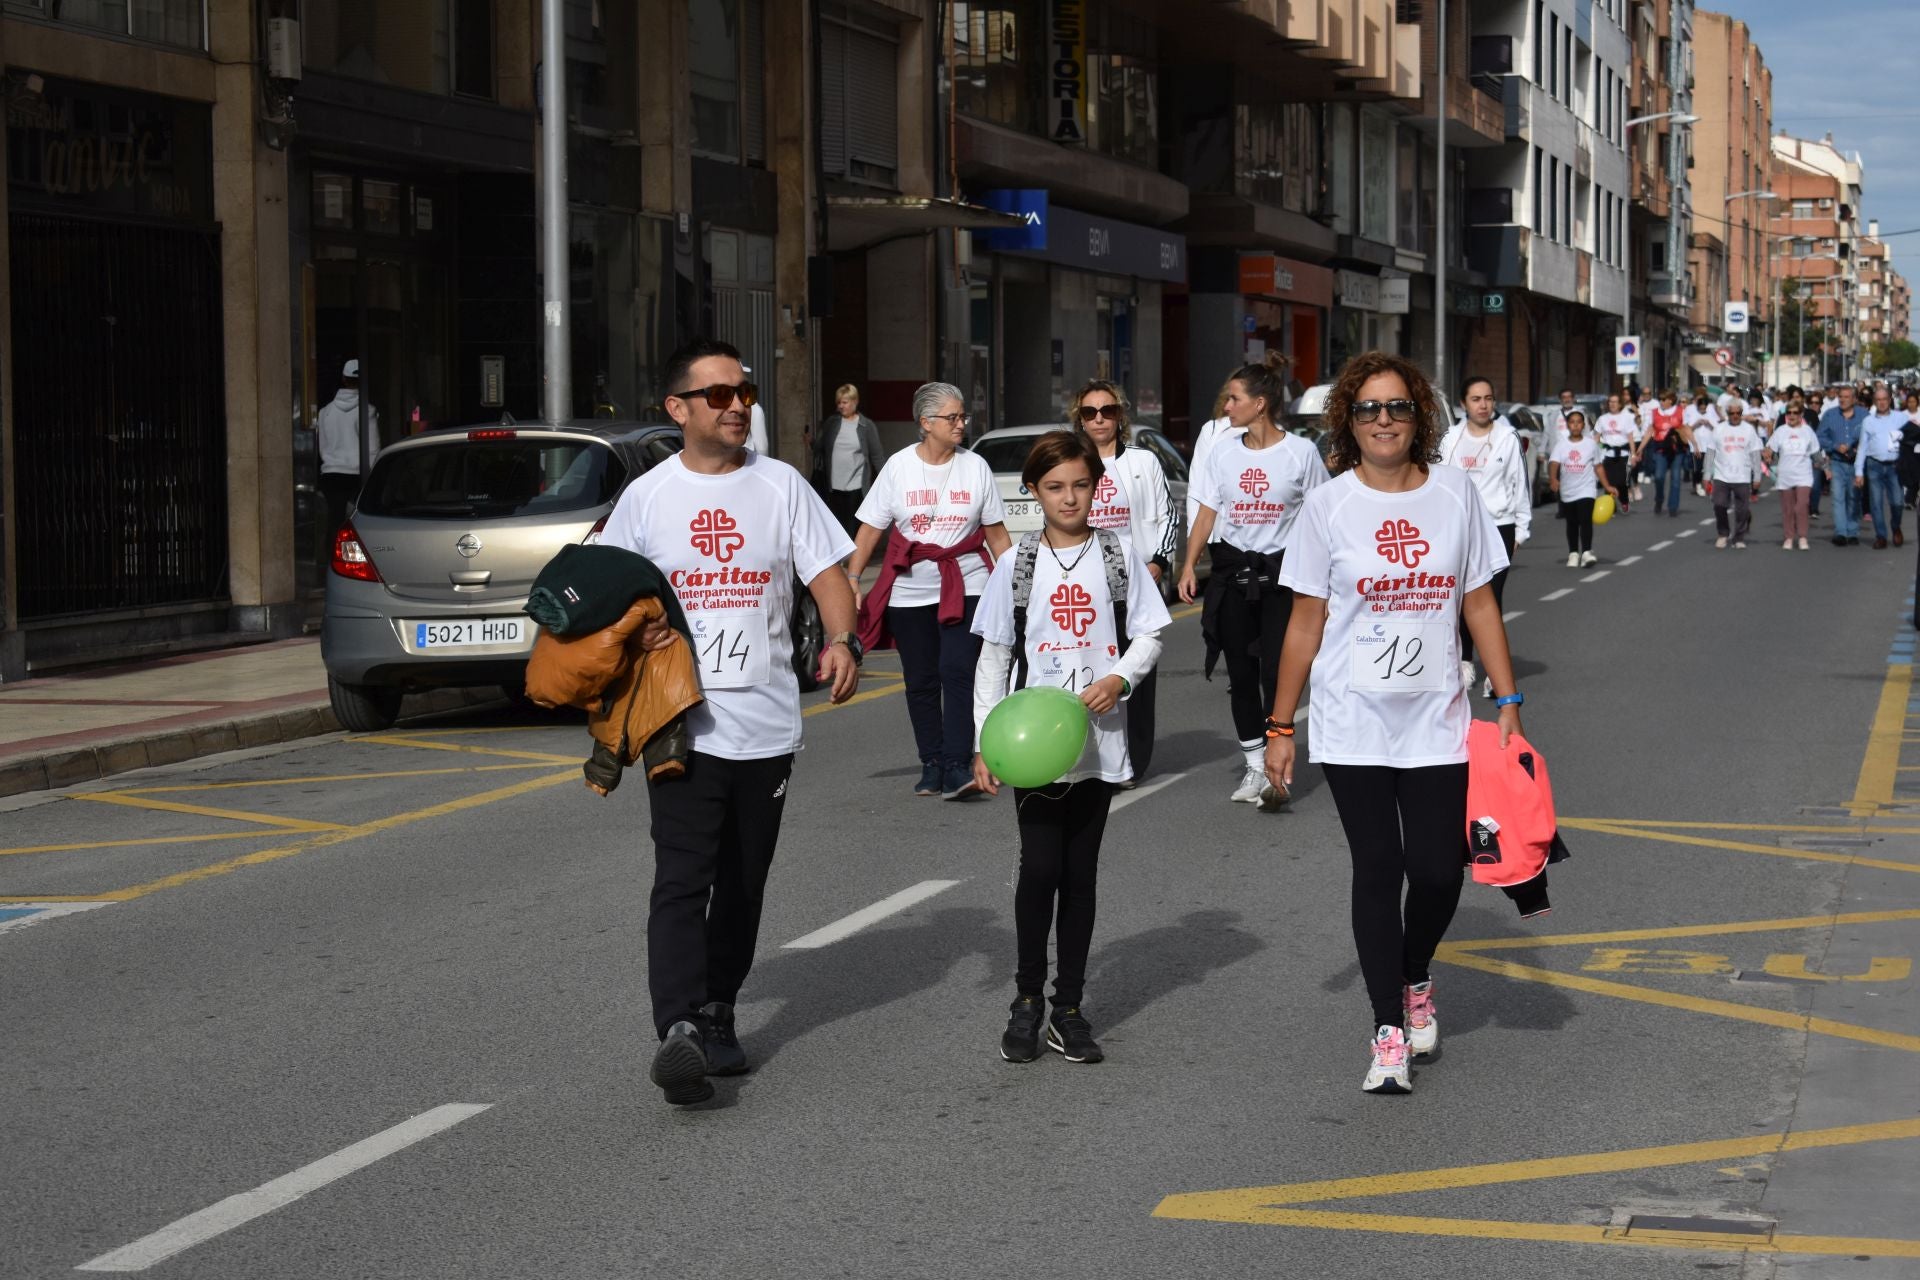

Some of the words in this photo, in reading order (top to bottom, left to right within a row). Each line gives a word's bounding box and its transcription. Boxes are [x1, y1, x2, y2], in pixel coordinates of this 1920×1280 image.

[1089, 227, 1110, 256] BBVA
[1160, 242, 1179, 269] BBVA
[1007, 504, 1029, 515] 328
[670, 566, 771, 589] Cáritas
[1356, 571, 1457, 596] Cáritas
[685, 600, 700, 612] de
[702, 598, 760, 610] Calahorra
[1371, 602, 1385, 612] de
[1388, 601, 1443, 612] Calahorra
[428, 625, 474, 643] 5021
[482, 622, 518, 641] HHD
[702, 629, 750, 673] 14
[1373, 635, 1425, 679] 12
